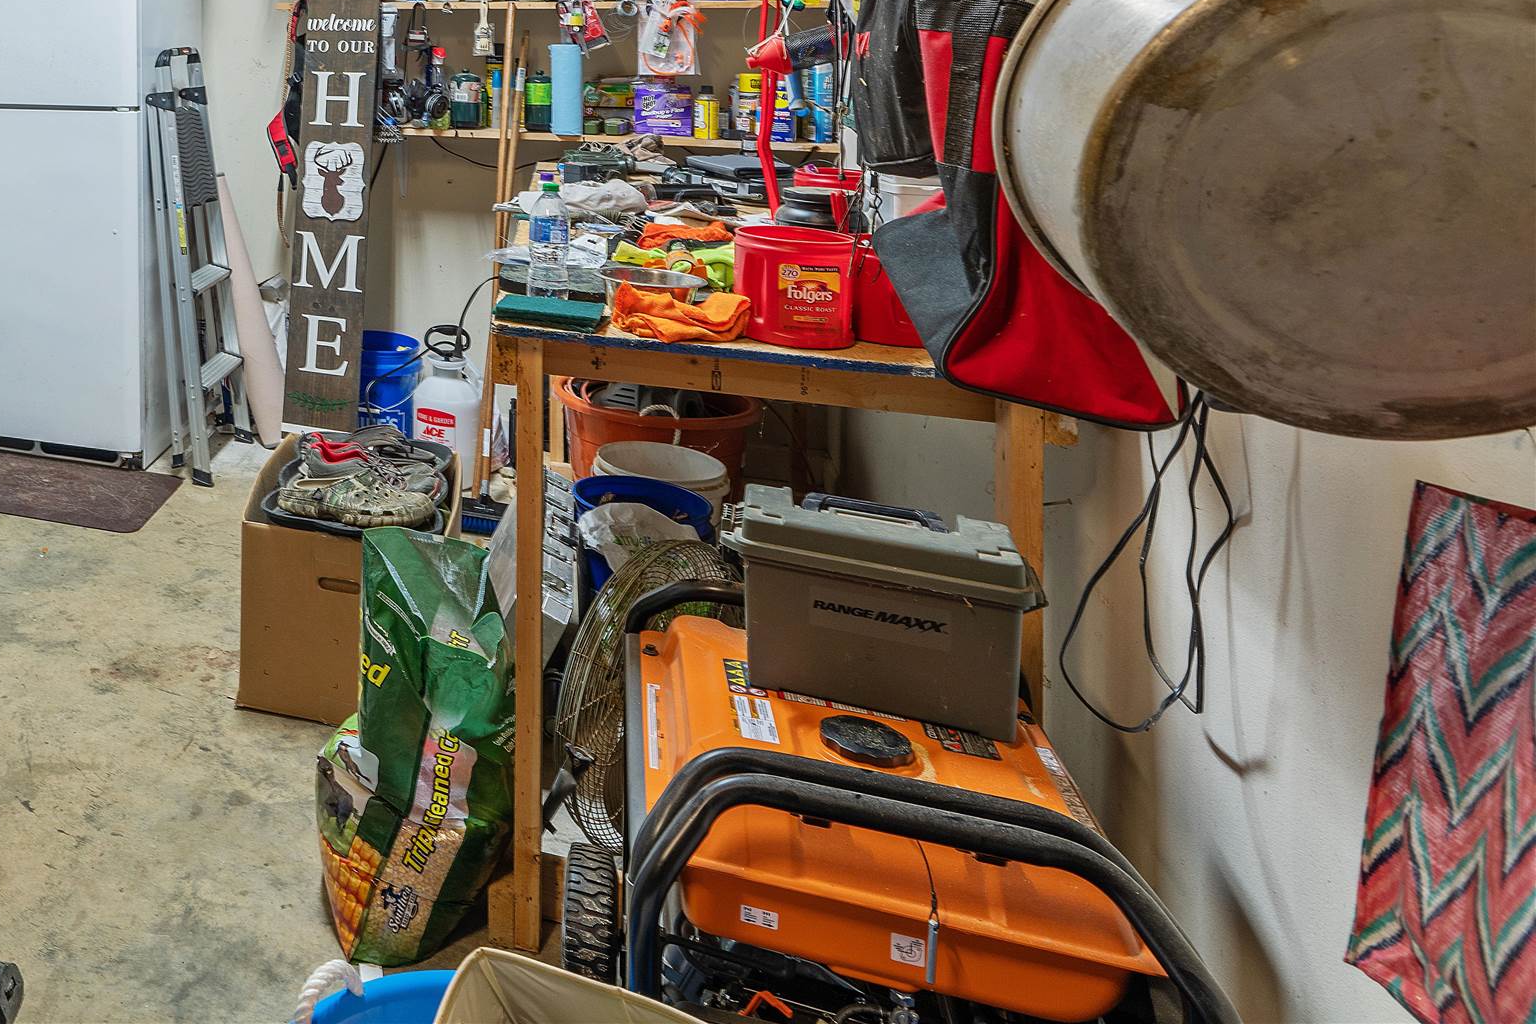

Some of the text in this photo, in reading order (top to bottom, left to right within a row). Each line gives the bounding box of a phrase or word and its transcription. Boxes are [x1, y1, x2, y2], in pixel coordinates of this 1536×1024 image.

[306, 13, 377, 32] welcome
[306, 39, 375, 54] TO OUR
[787, 284, 833, 304] Folgers
[784, 303, 814, 312] CLASSIC
[433, 416, 454, 425] GARDEN
[422, 425, 446, 438] ACE
